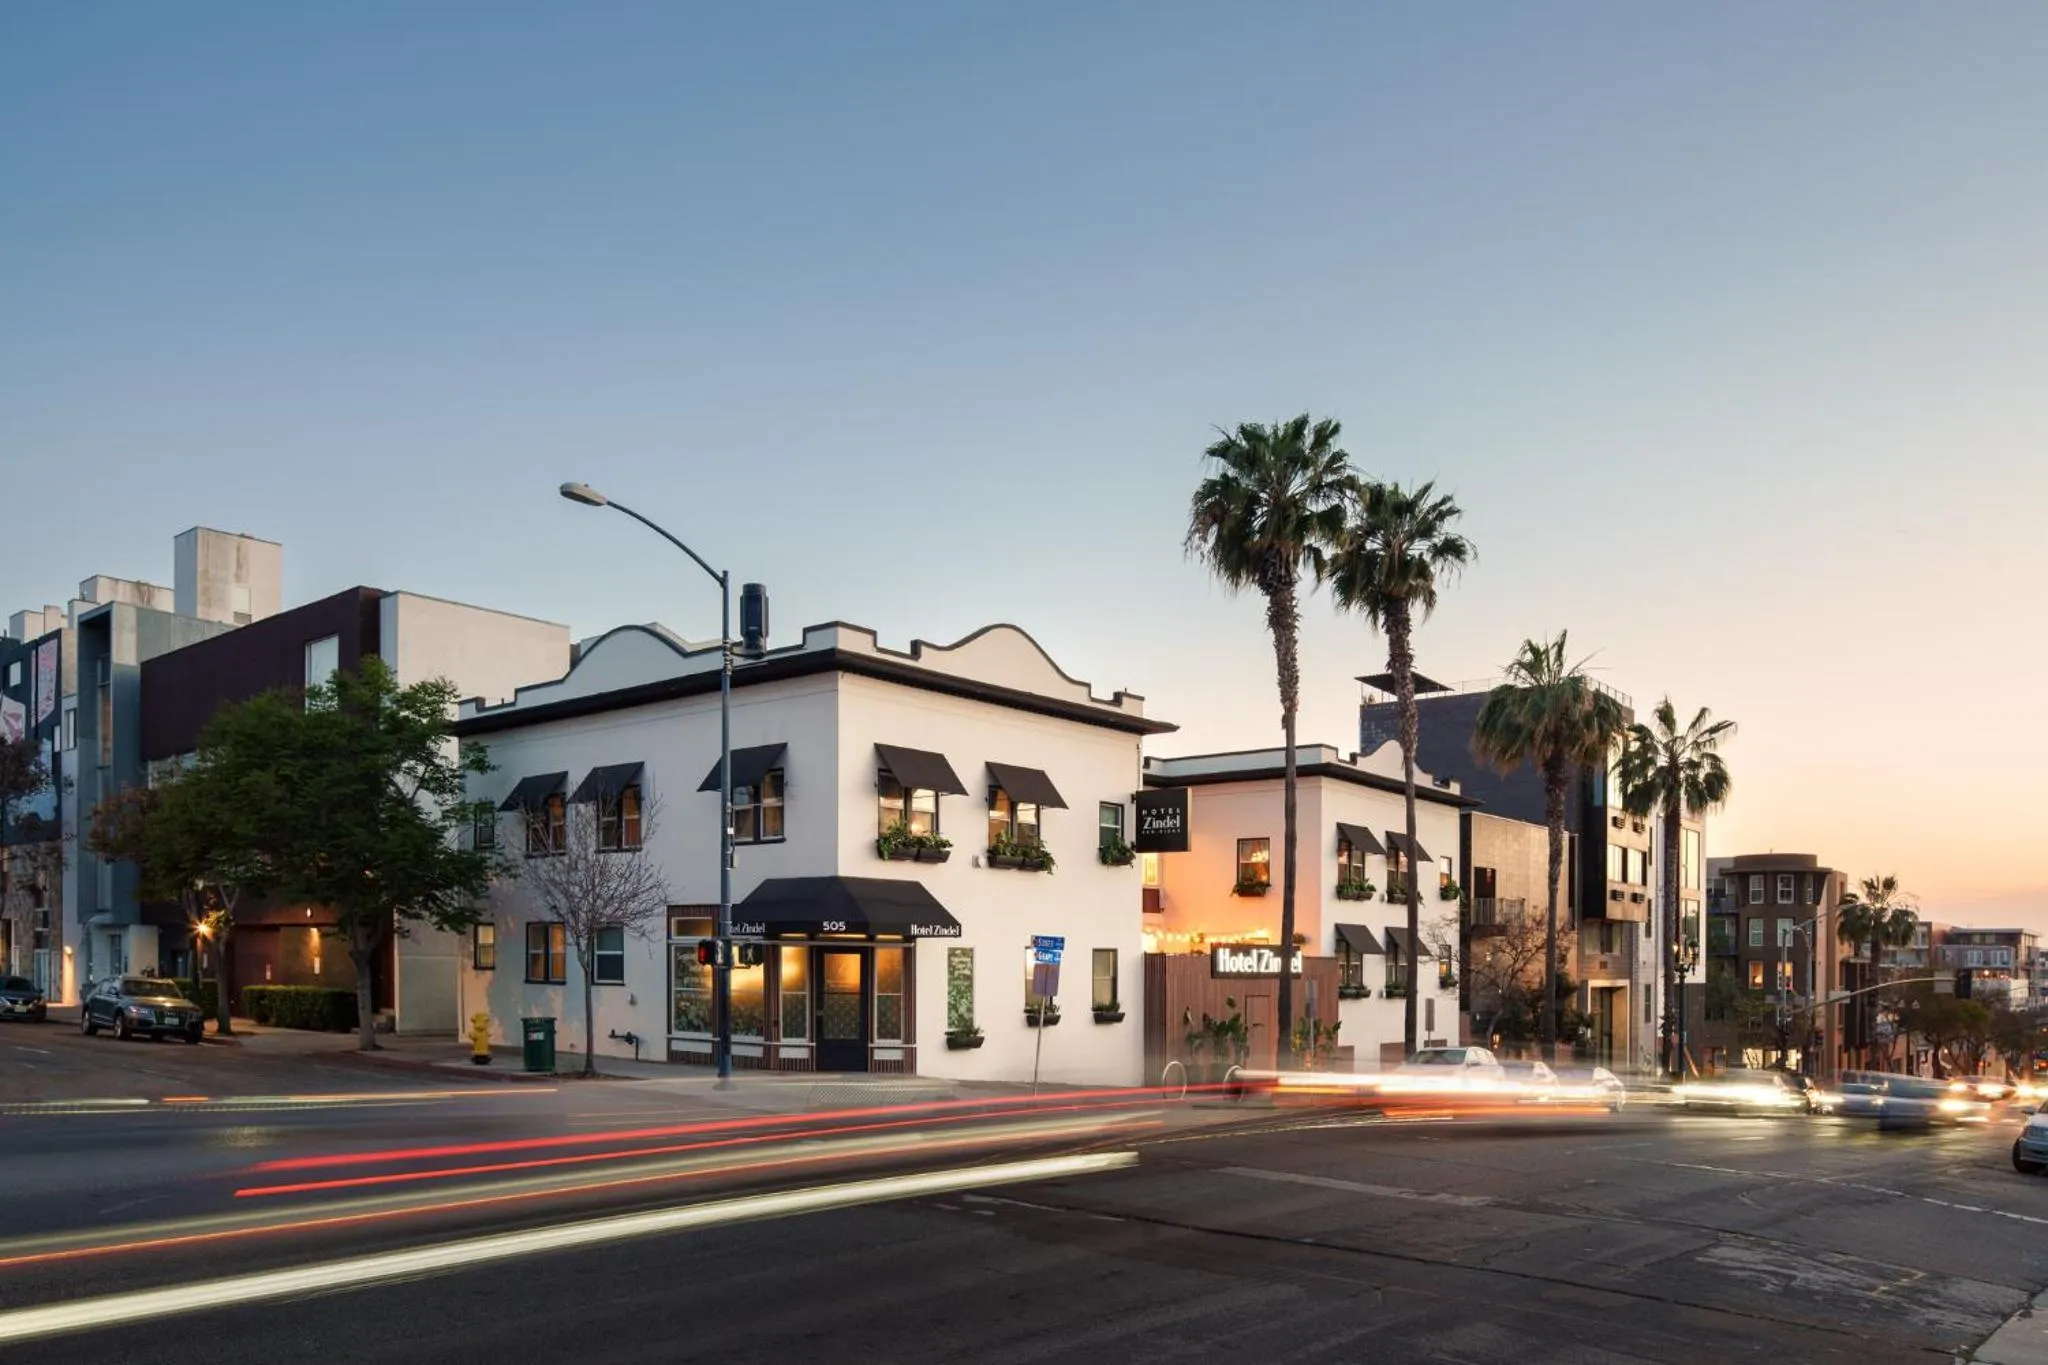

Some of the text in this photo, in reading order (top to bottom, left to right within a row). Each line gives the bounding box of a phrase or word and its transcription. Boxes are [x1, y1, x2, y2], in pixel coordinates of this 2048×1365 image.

[1142, 807, 1180, 815] HOTEL
[1143, 815, 1180, 829] Zindel
[742, 922, 765, 933] Zindel
[822, 920, 847, 931] 505
[911, 924, 960, 936] Hotel Zindel
[1218, 948, 1303, 973] Hotel Zinel
